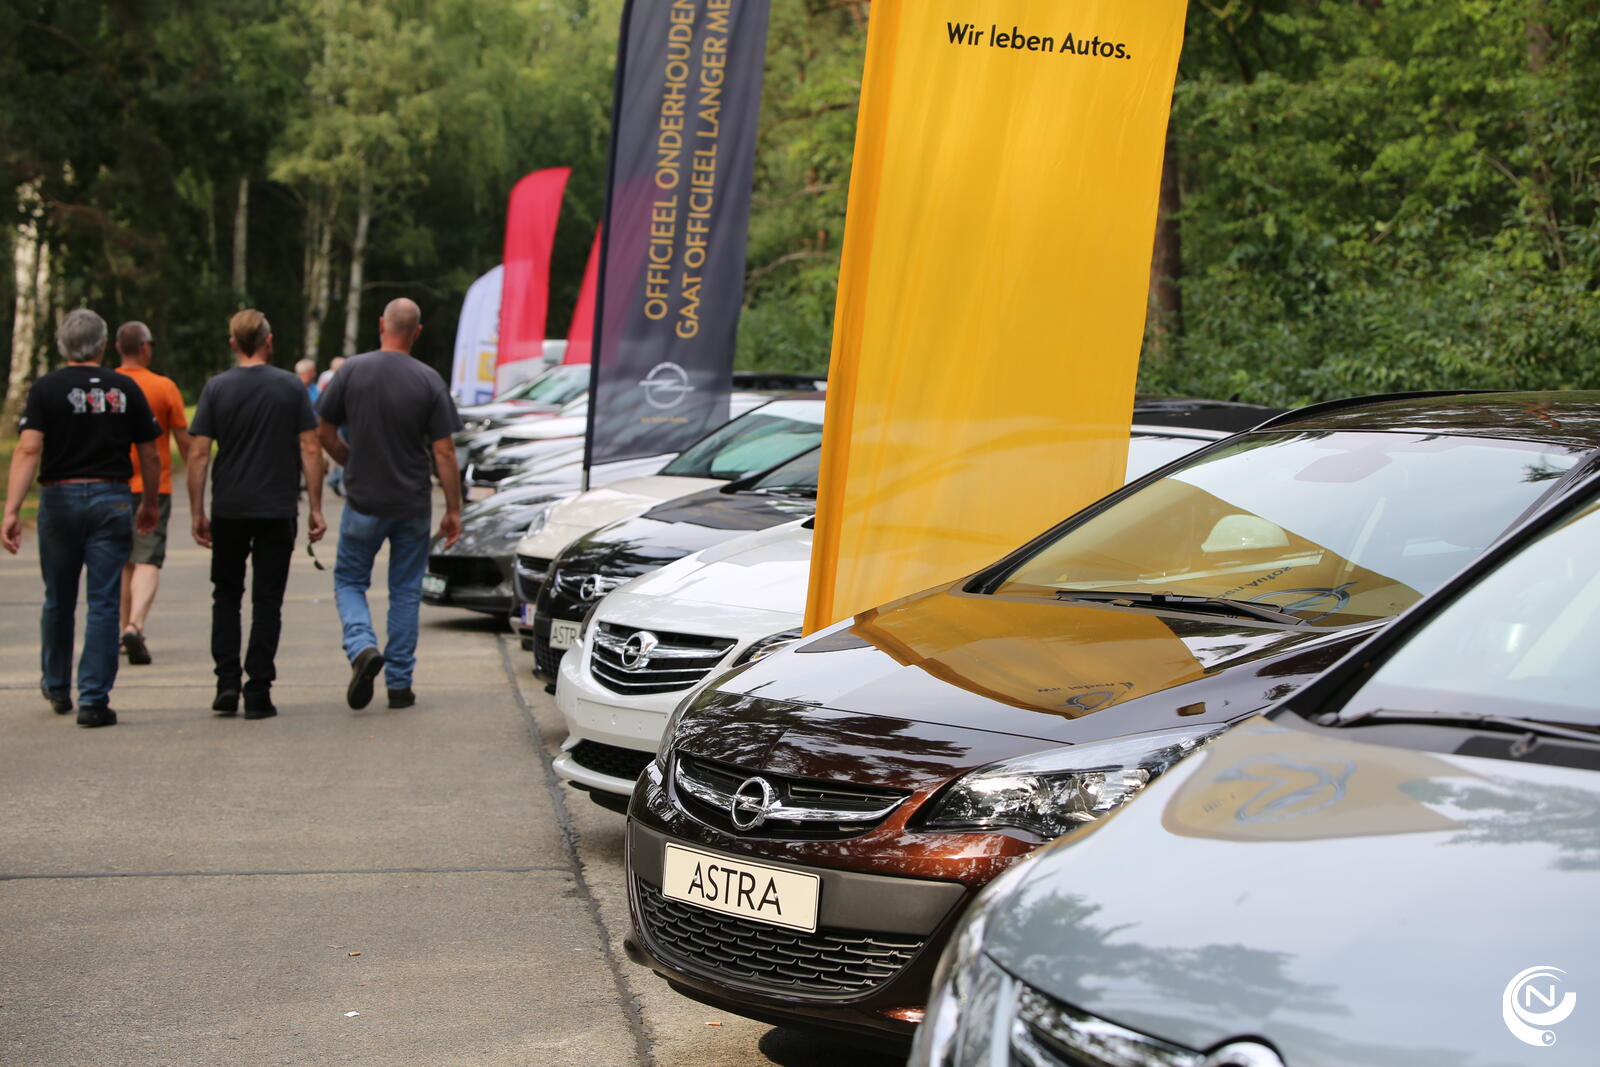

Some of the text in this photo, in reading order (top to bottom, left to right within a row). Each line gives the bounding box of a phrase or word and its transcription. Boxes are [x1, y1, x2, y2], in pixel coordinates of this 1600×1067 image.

[947, 22, 1132, 61] Wir leben Autos.
[696, 37, 728, 138] LANGER
[683, 144, 718, 268] OFFICIEEL
[644, 195, 678, 320] OFFICIEEL
[676, 272, 702, 338] GAAT
[552, 626, 578, 646] ASTR
[687, 861, 782, 916] ASTRA
